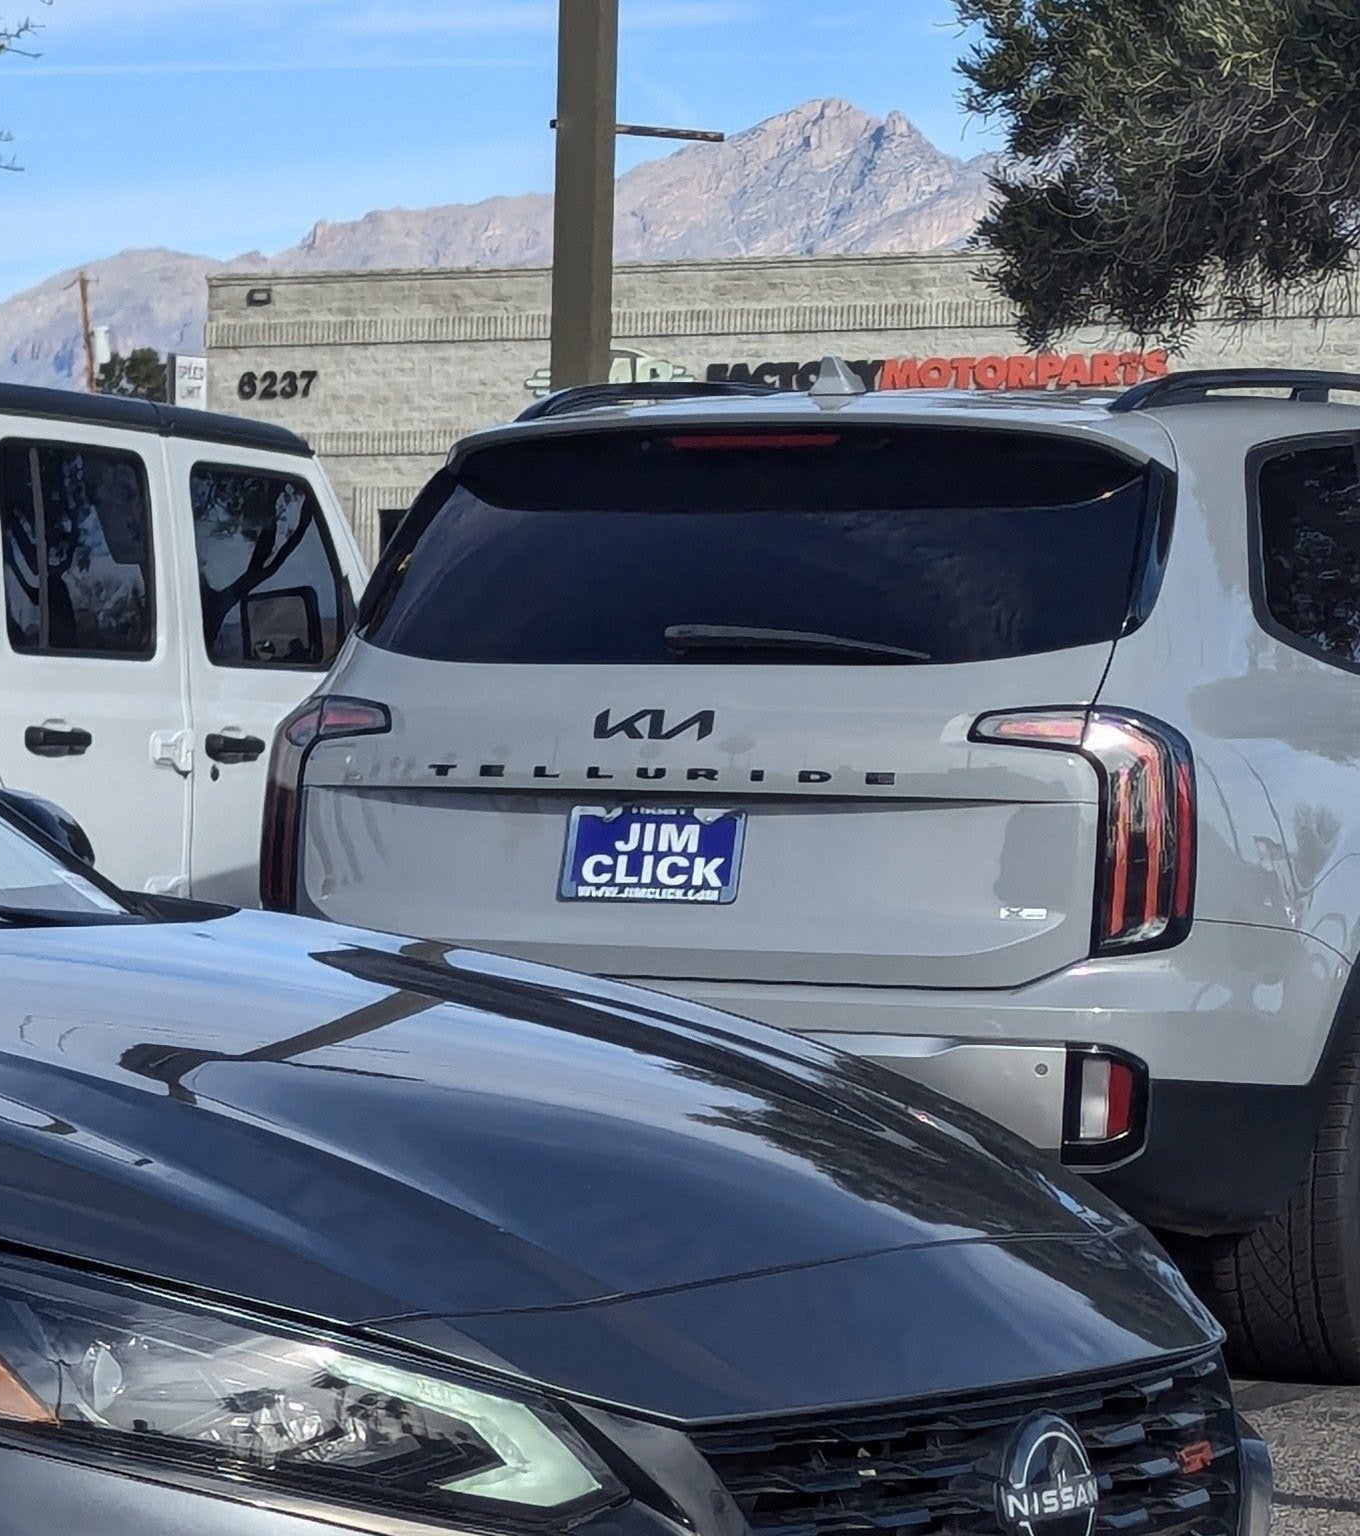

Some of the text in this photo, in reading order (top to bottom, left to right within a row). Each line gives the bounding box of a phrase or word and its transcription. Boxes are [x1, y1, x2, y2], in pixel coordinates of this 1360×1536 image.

[880, 349, 1168, 388] MOTORPARTS
[238, 370, 317, 400] 6237
[594, 709, 715, 741] KIA
[429, 764, 895, 785] TELLURIDE
[615, 823, 700, 853] JIM
[582, 855, 725, 888] CLICK
[1005, 1477, 1099, 1518] NISSAN
